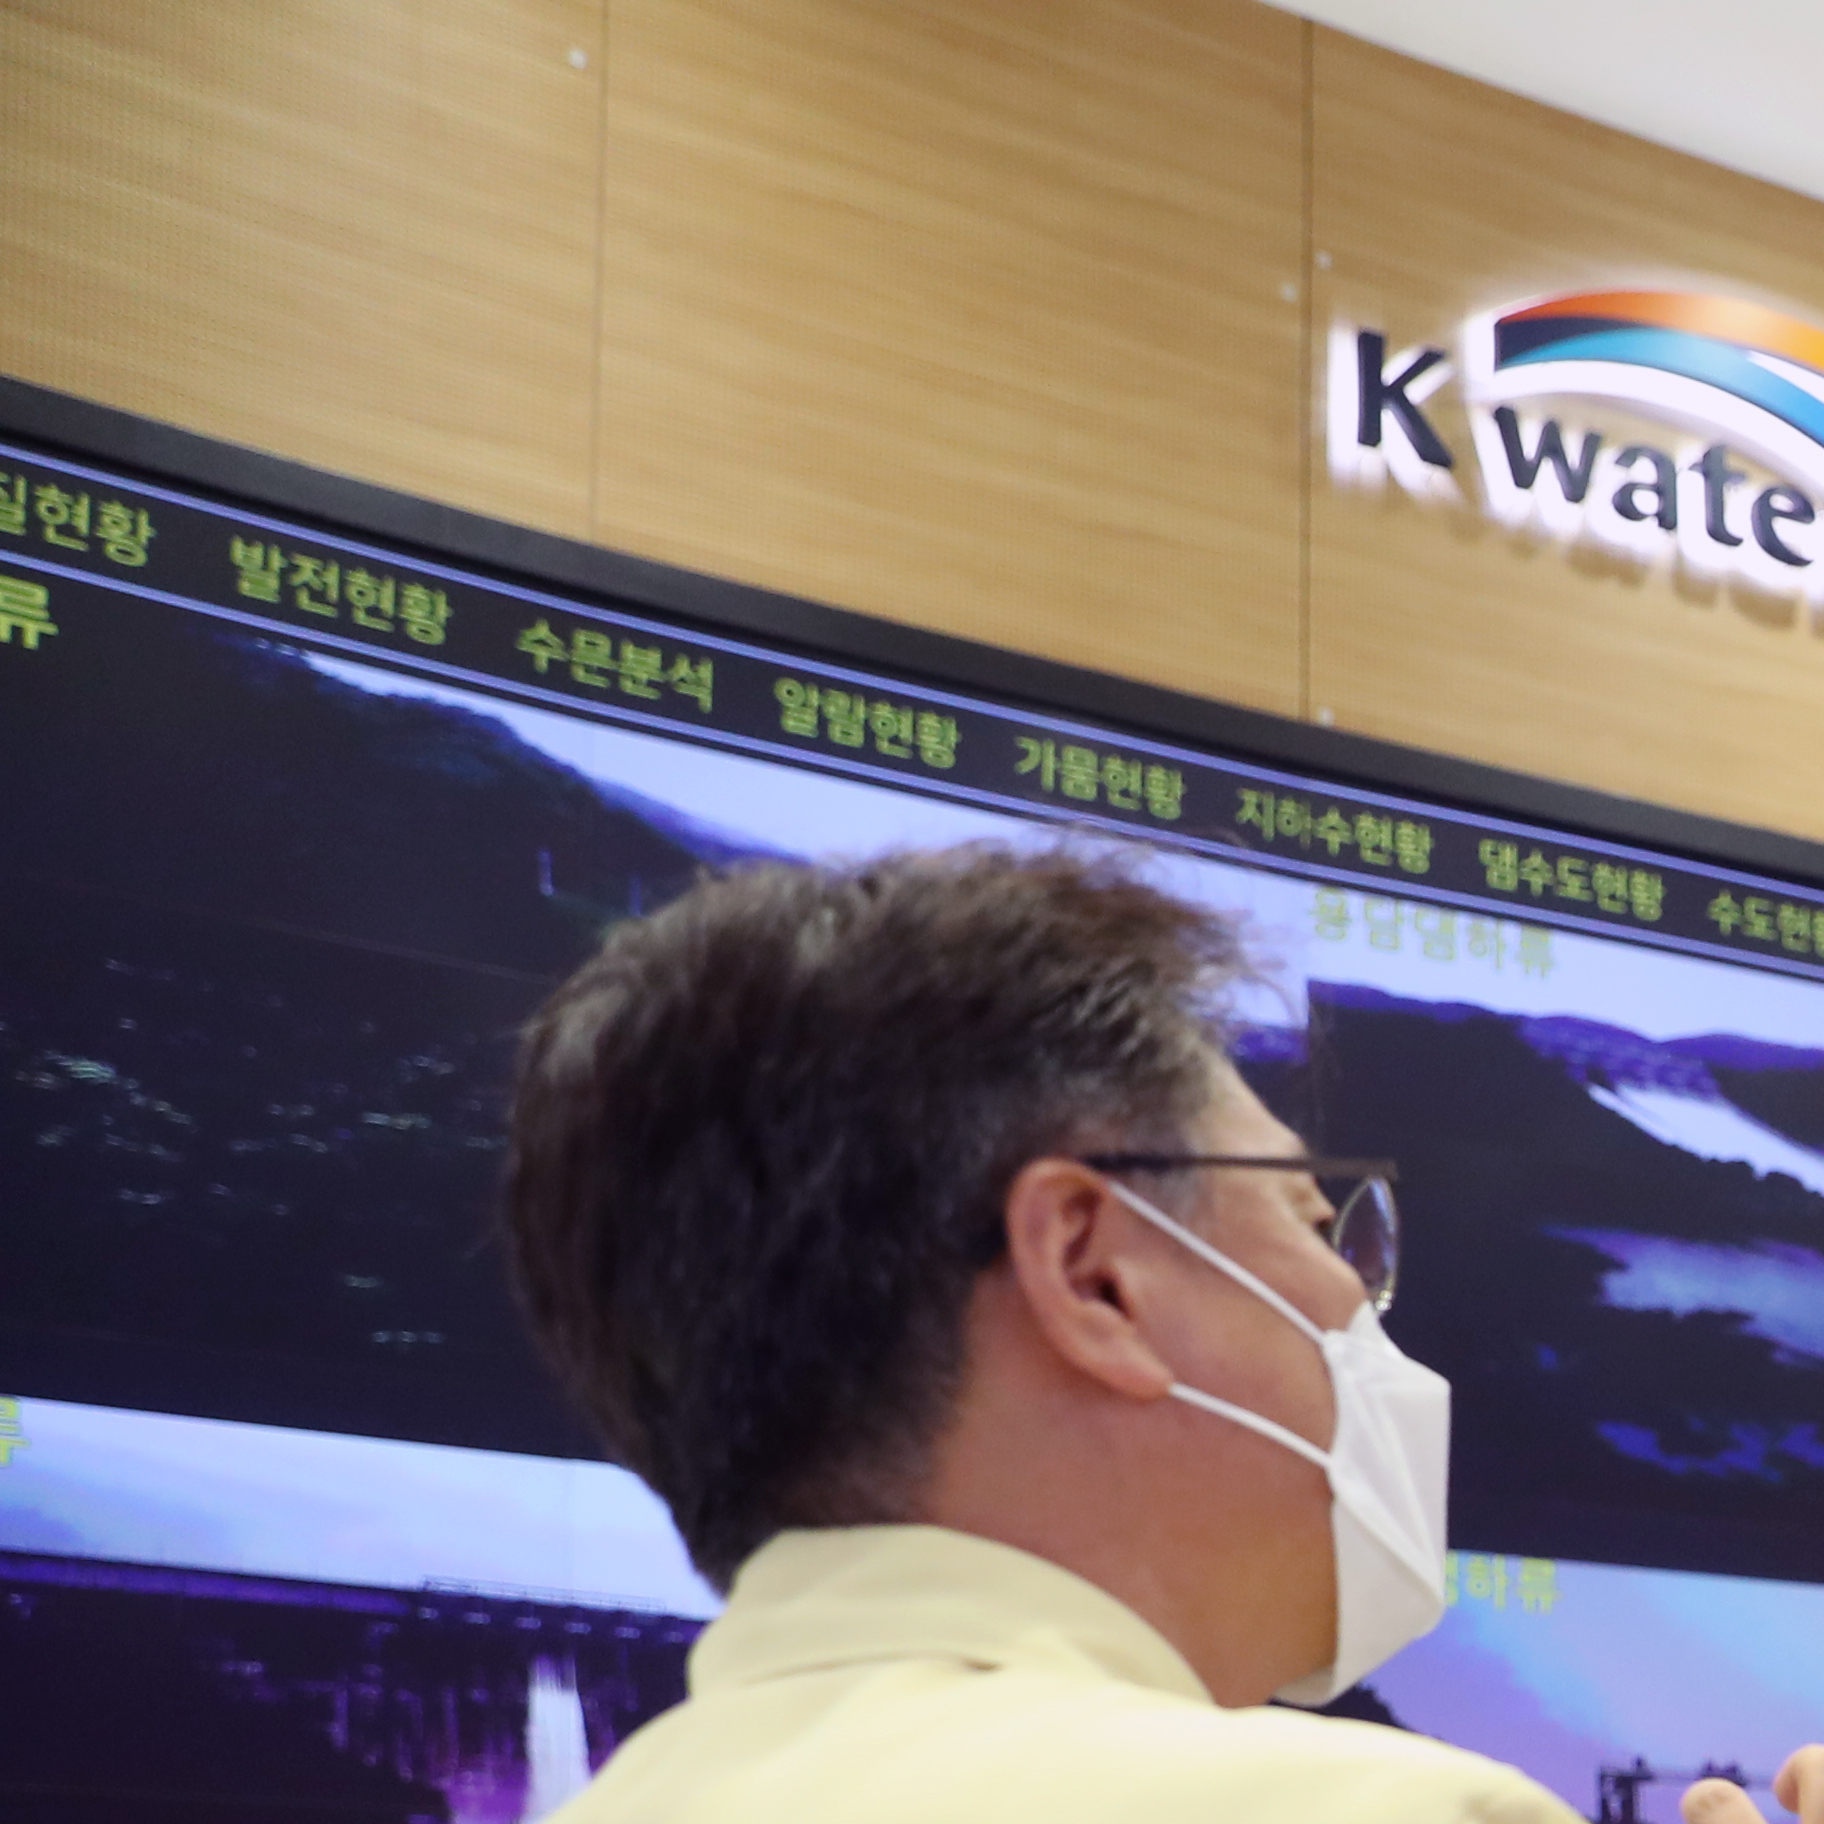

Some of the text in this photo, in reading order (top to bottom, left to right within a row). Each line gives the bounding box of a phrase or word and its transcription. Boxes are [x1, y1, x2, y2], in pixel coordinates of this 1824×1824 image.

[229, 536, 452, 646] 발전현황
[516, 619, 715, 713] 수문분석
[773, 677, 960, 769] 알림현황
[1015, 736, 1184, 820] 가뭄현황
[1236, 788, 1433, 874] 지하수현황
[1478, 838, 1665, 922] 댐수도현황
